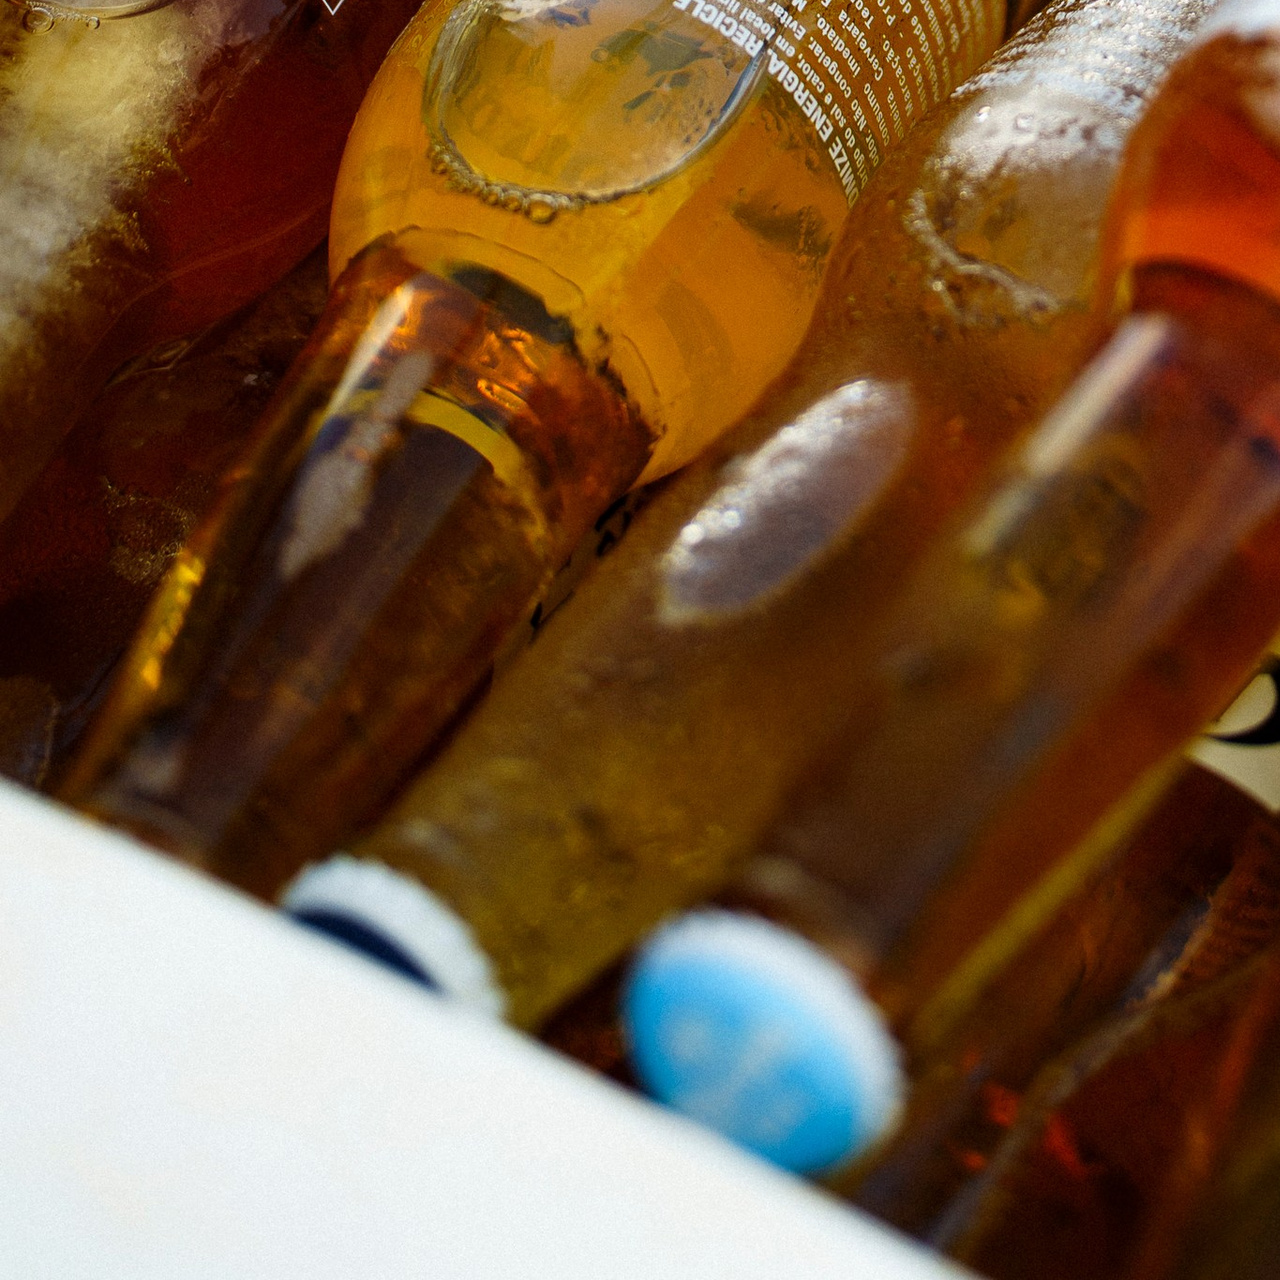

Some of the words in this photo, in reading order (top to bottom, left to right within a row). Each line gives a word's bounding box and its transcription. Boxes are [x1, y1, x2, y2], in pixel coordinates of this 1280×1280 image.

[739, 6, 774, 39] local
[767, 0, 805, 40] Evitar
[772, 32, 797, 58] em
[818, 12, 860, 78] imediato.
[835, 9, 884, 81] Cervejaria
[807, 36, 852, 99] congelar.
[880, 34, 913, 116] Marcação.
[767, 47, 832, 142] ENERGIA.
[821, 91, 835, 105] e
[850, 98, 865, 131] Não
[862, 82, 891, 146] consumo
[830, 102, 846, 128] sol
[845, 126, 855, 146] do
